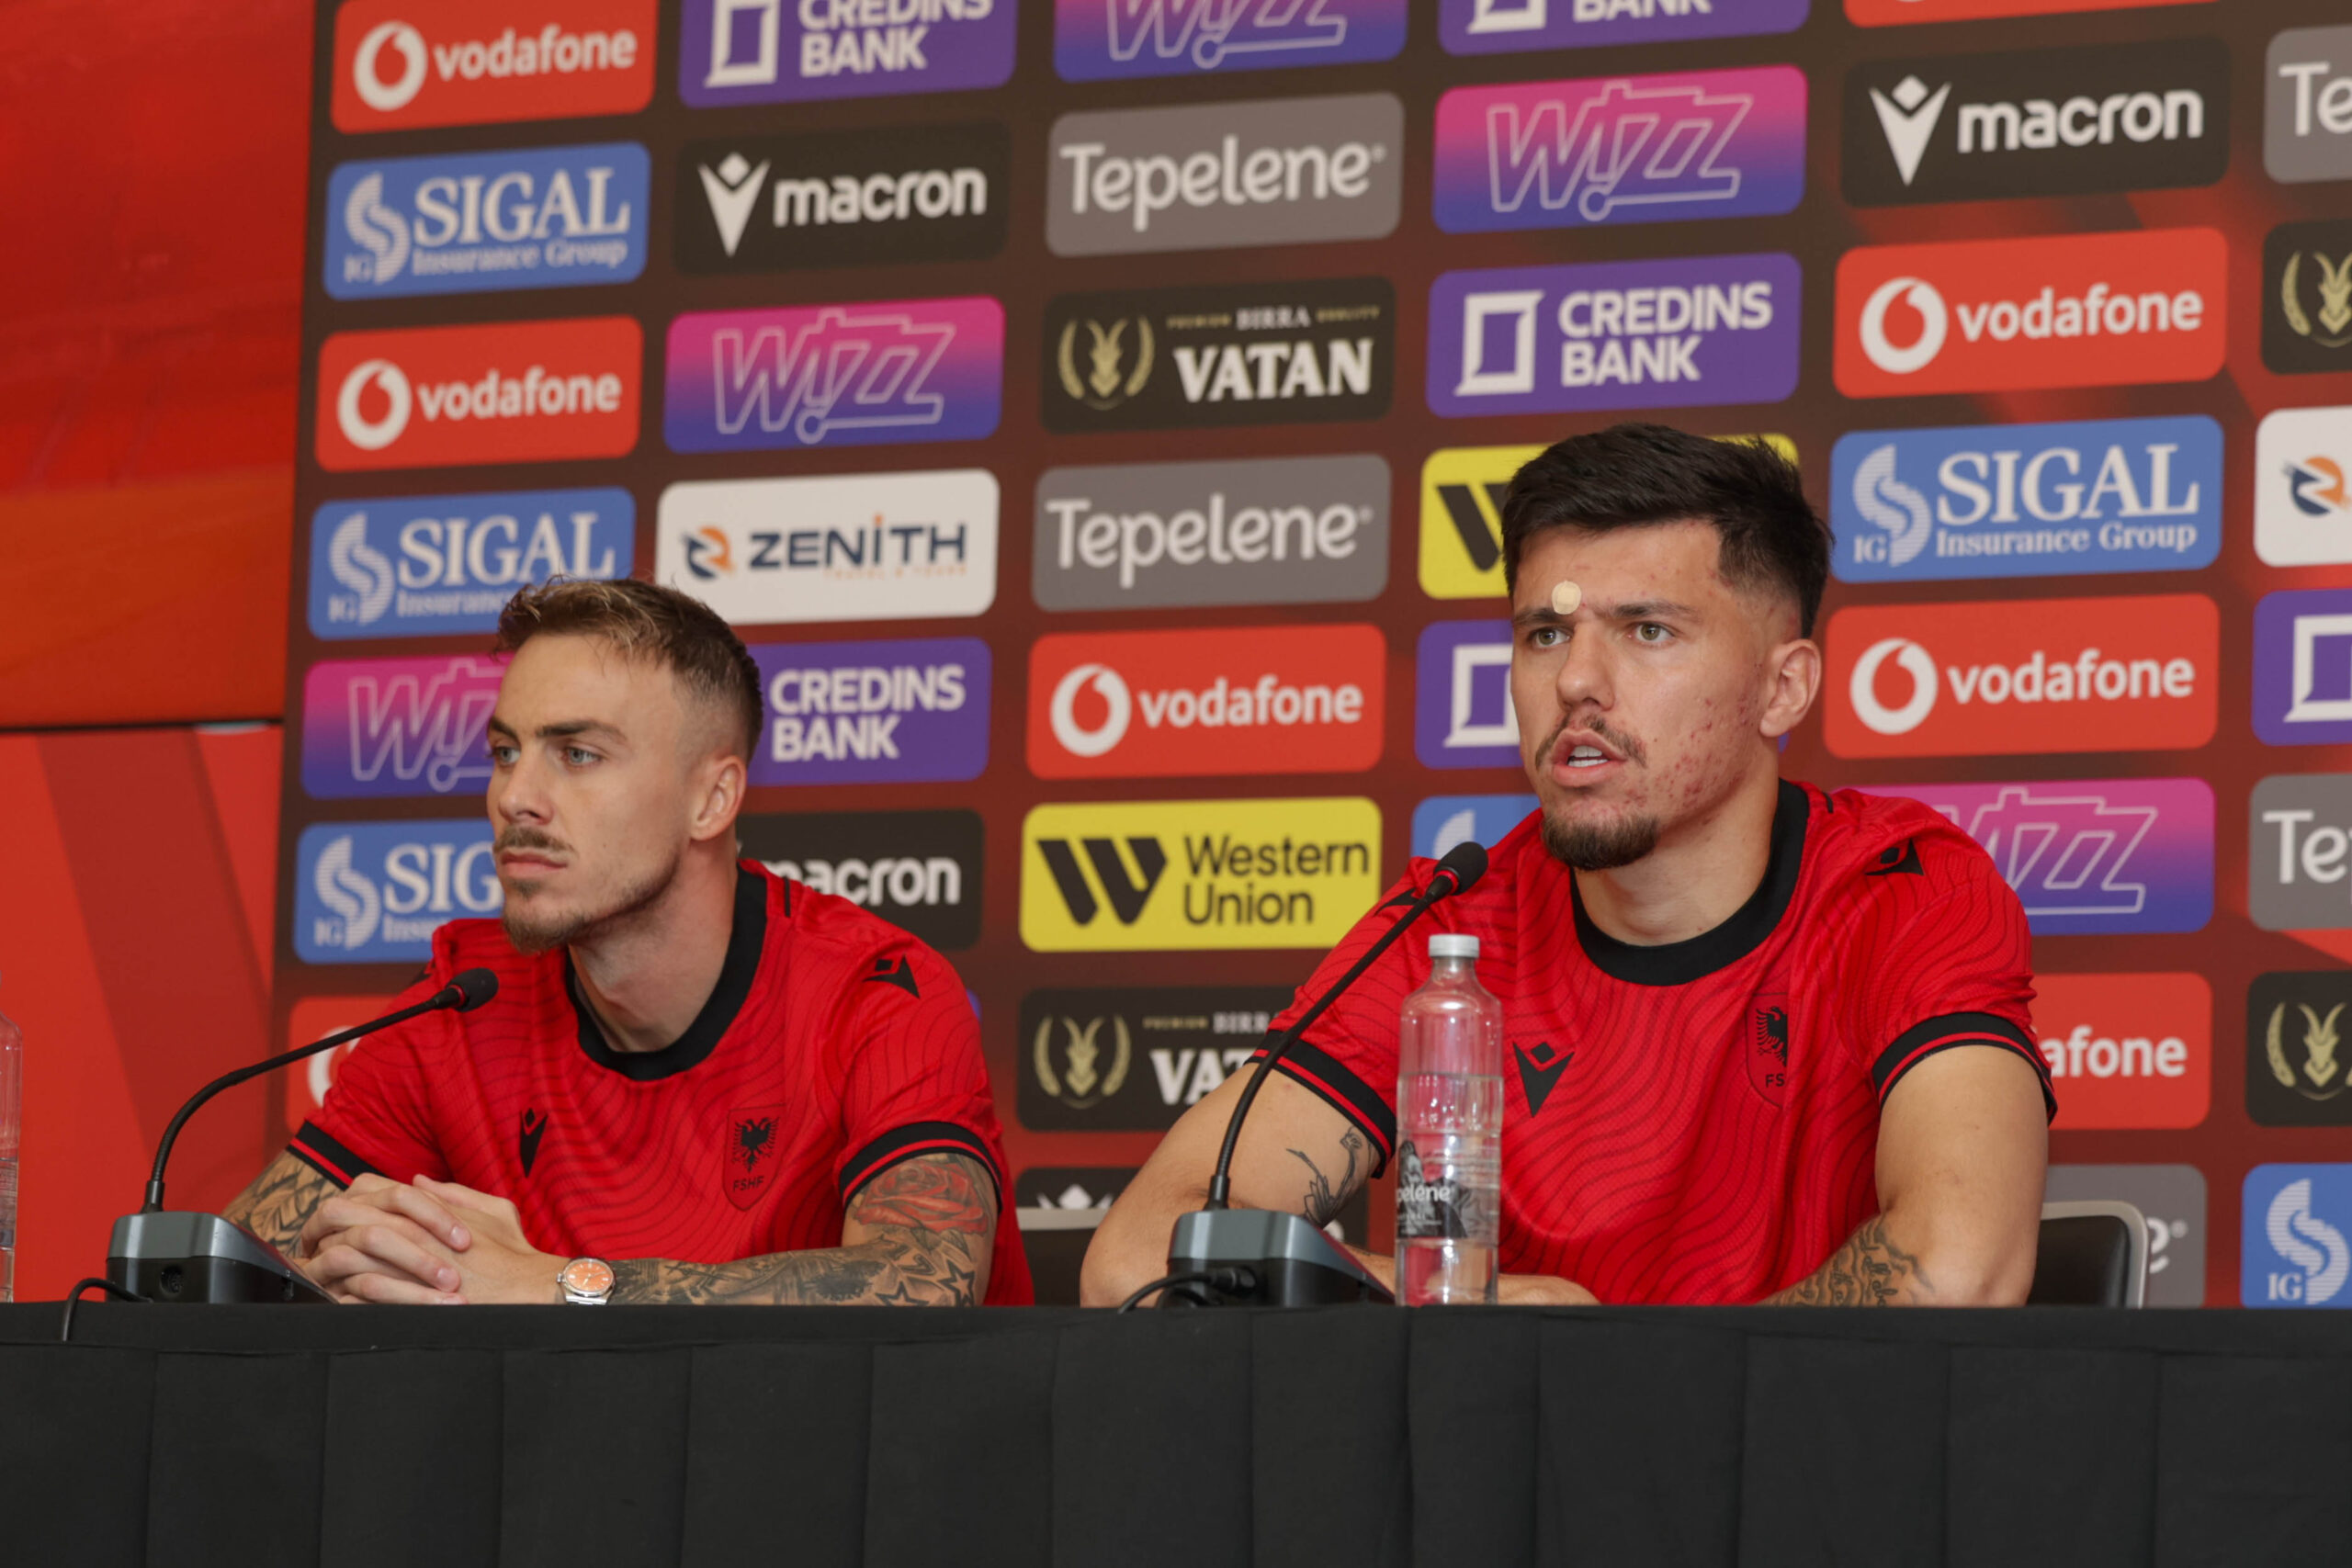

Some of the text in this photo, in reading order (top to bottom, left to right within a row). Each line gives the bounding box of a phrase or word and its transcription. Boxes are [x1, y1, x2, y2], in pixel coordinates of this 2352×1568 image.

[433, 24, 639, 82] vodafone
[800, 25, 928, 77] BANK
[1958, 90, 2203, 153] macron
[413, 166, 631, 248] SIGAL
[774, 168, 988, 227] macron
[1060, 135, 1370, 231] Tepelene
[413, 238, 628, 276] Insurance Group
[1237, 307, 1310, 331] BIRRA
[1558, 282, 1773, 337] CREDINS
[1956, 282, 2204, 342] vodafone
[1173, 337, 1374, 402] VATAN
[1561, 335, 1702, 387] BANK
[417, 366, 623, 421] vodafone
[1937, 444, 2199, 526] SIGAL
[397, 511, 616, 589] SIGAL
[1046, 493, 1358, 589] Tepelene
[1936, 521, 2198, 558] Insurance Group
[397, 590, 515, 617] Insuran
[770, 664, 966, 715] CREDINS
[1138, 674, 1363, 728] vodafone
[1947, 648, 2195, 705] vodafone
[772, 715, 899, 762] BANK
[383, 840, 503, 914] SIG
[1183, 834, 1370, 878] Western
[1183, 882, 1314, 926] Union
[1213, 1011, 1275, 1034] BIRR
[733, 1176, 764, 1191] FSHF
